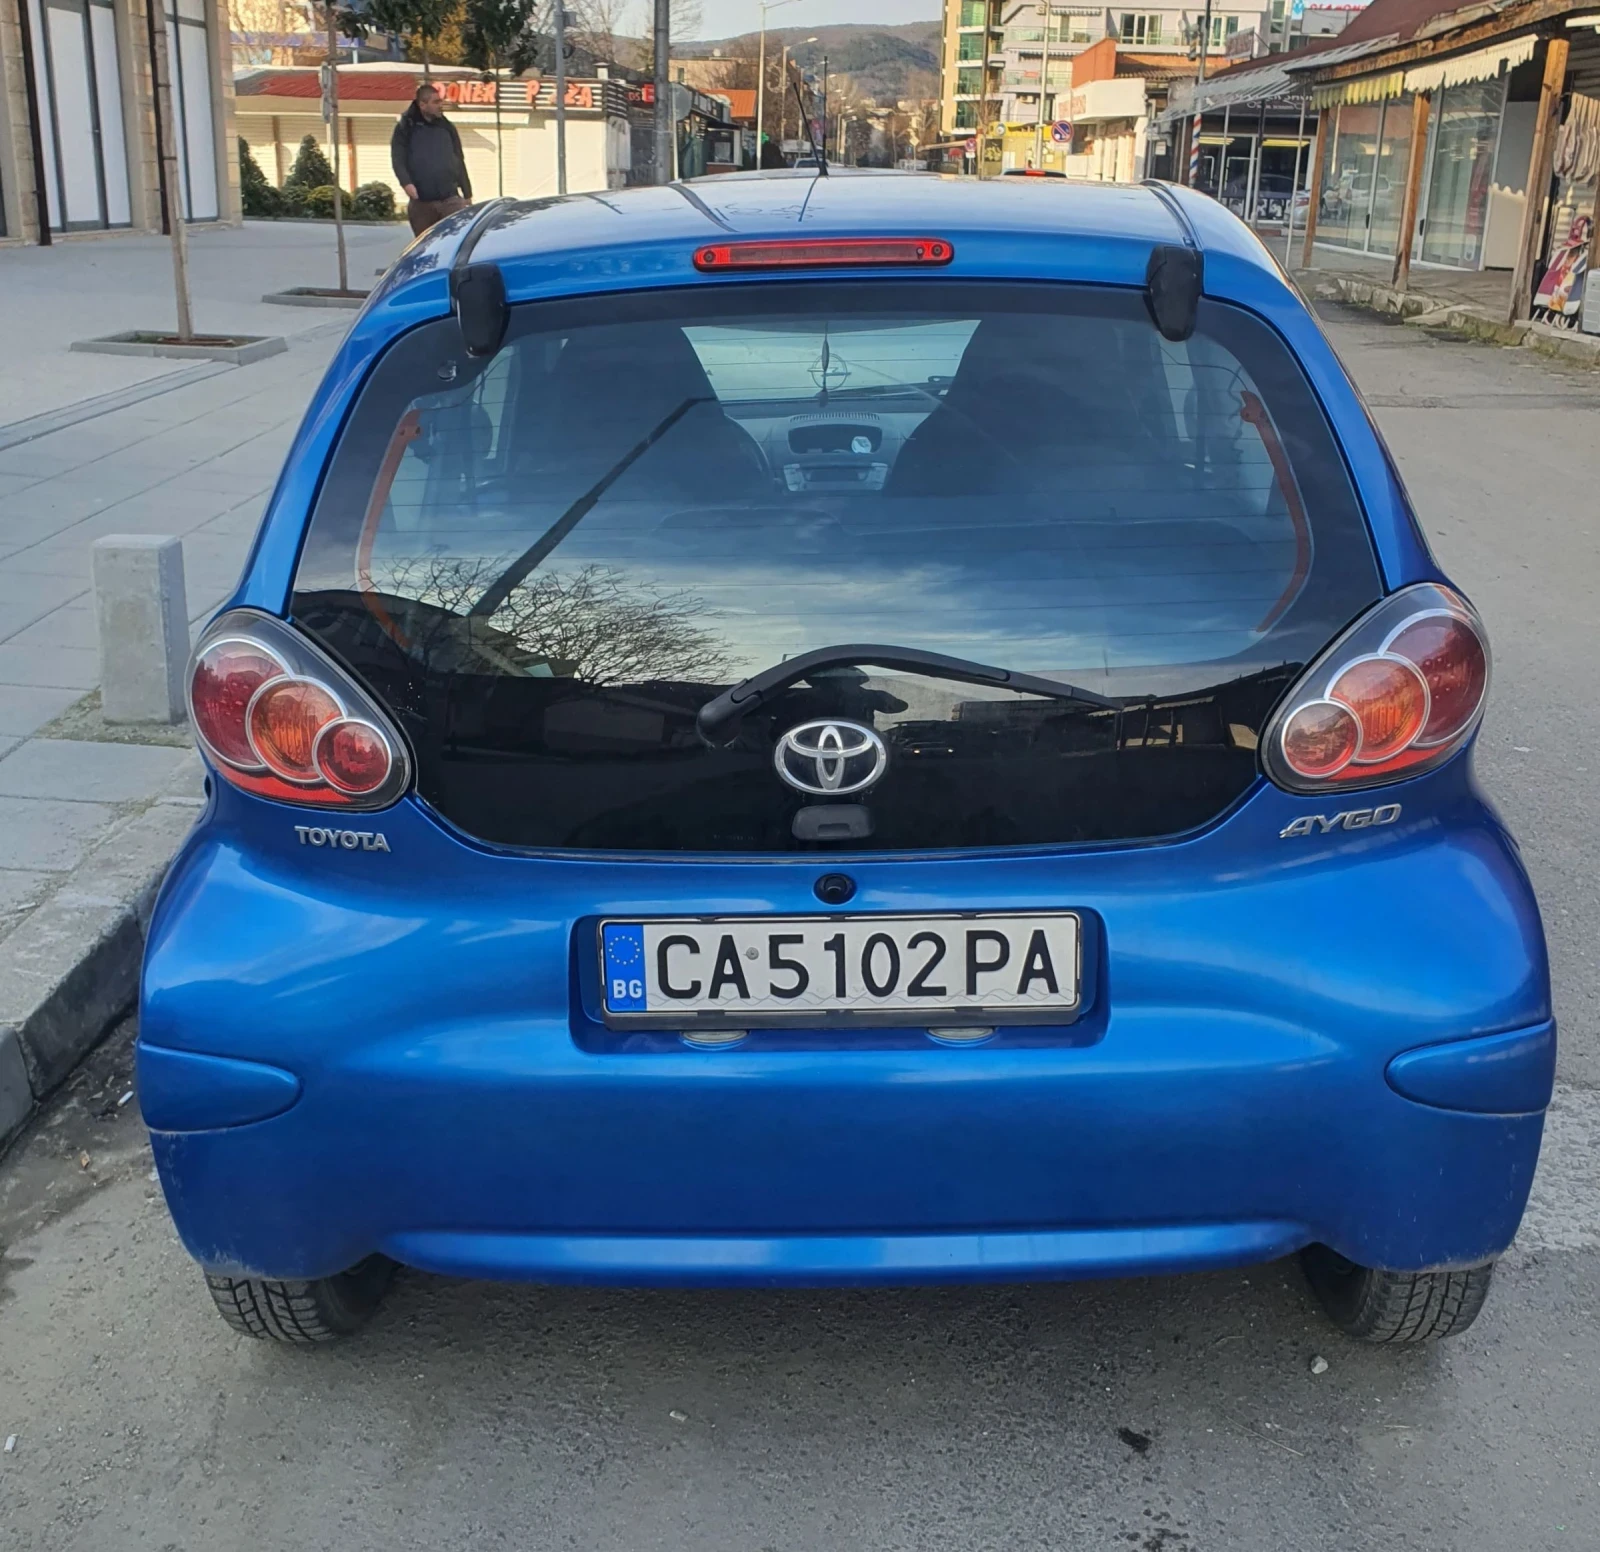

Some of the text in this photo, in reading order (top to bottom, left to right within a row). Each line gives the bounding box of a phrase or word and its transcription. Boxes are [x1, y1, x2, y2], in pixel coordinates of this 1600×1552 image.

[1279, 803, 1402, 839] AYGO
[294, 825, 392, 852] TOYOTA
[656, 929, 1059, 999] CA 5102 PA
[612, 979, 643, 999] BG
